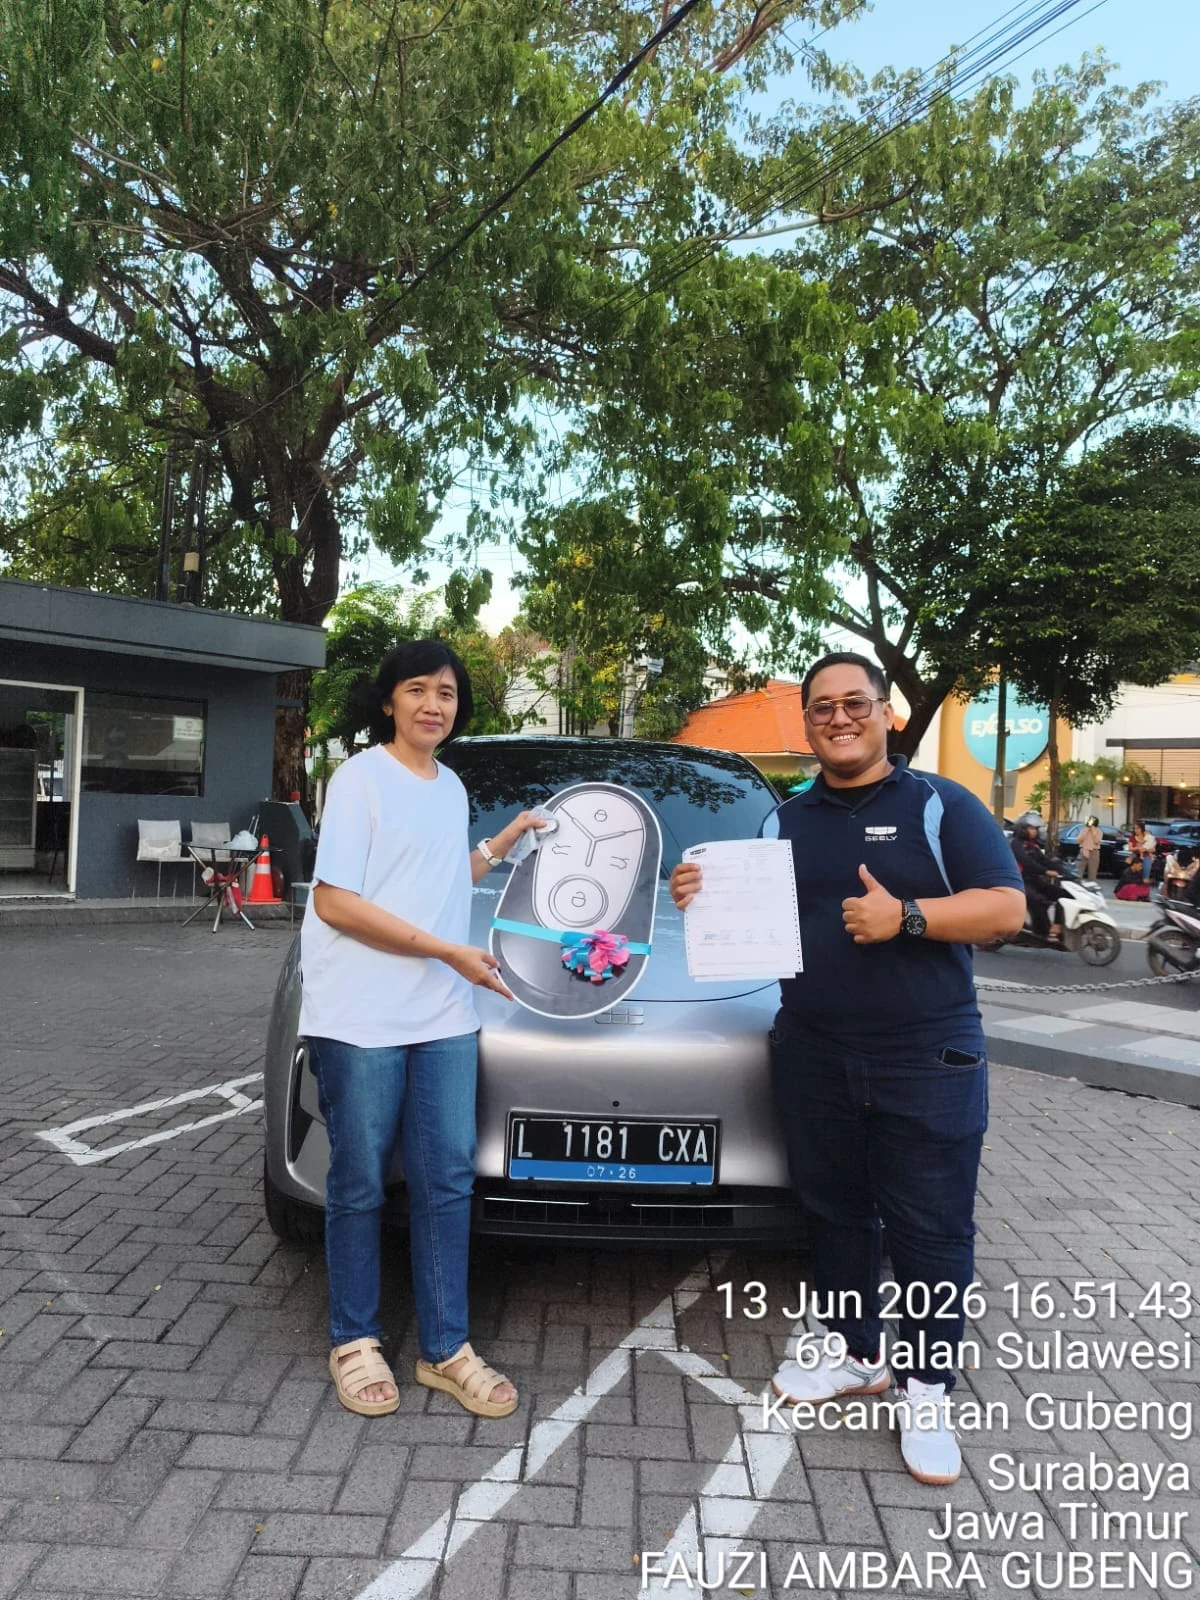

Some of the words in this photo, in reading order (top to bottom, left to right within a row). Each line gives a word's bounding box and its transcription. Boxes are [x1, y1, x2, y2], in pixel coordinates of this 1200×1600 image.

[518, 1124, 533, 1158] L
[563, 1125, 628, 1159] 1181
[658, 1127, 708, 1163] CXA
